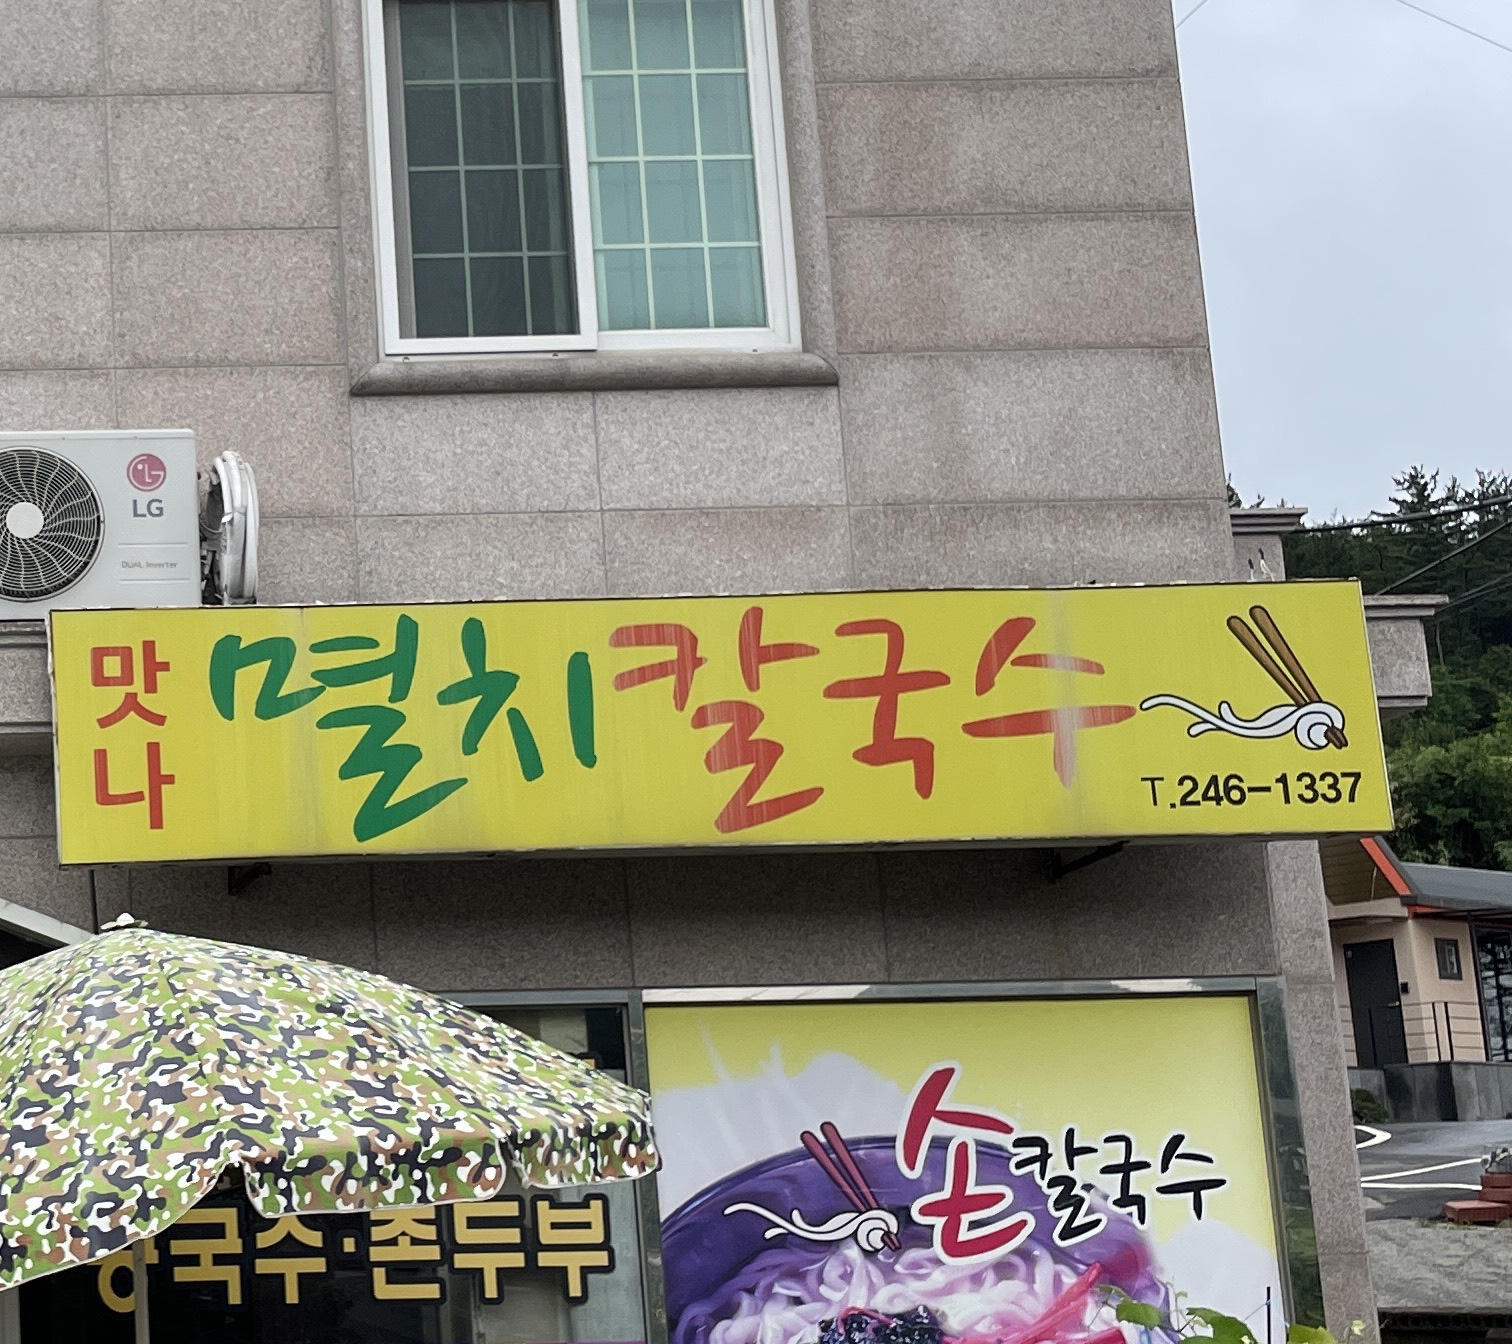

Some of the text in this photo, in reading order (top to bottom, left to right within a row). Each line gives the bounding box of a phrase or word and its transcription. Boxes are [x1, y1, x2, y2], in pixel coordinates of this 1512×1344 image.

[132, 498, 165, 519] LG
[89, 639, 175, 831] 맛나
[1140, 771, 1363, 810] T.246-1337
